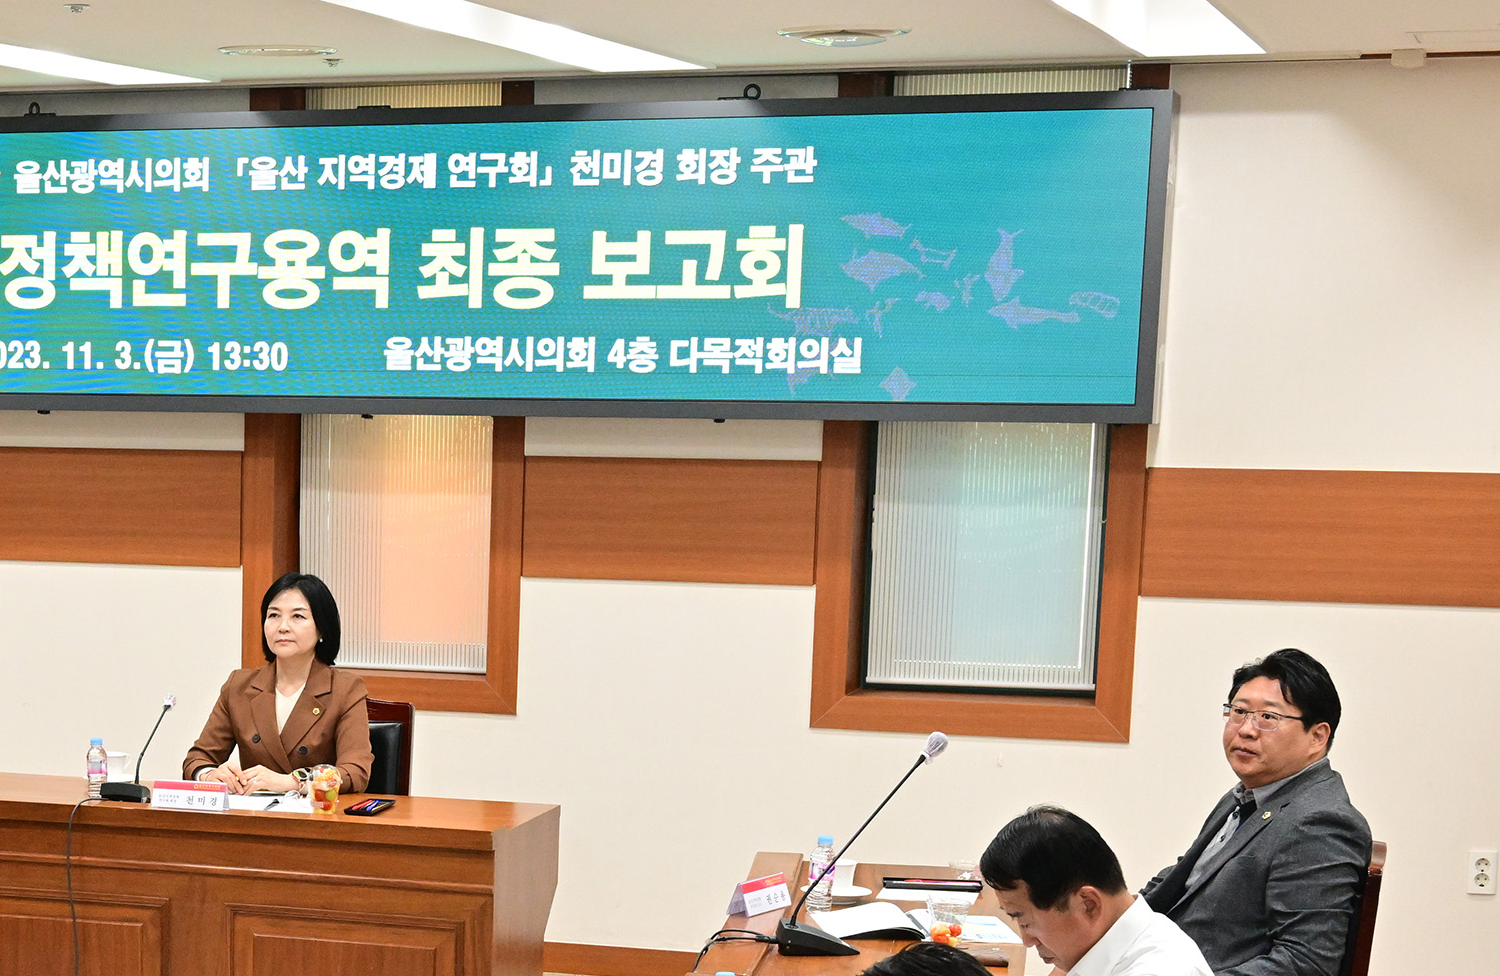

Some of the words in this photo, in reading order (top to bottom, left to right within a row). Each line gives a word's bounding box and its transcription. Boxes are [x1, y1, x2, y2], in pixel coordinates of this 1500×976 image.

[13, 156, 210, 194] 울산광역시의회
[317, 152, 437, 191] 지역경제
[447, 151, 552, 188] 연구회」
[569, 149, 664, 186] 천미경
[675, 147, 741, 186] 회장
[750, 146, 818, 184] 주관
[416, 226, 560, 310] 최종
[583, 223, 805, 309] 보고회
[62, 341, 104, 370] 11.
[207, 341, 289, 371] 13:30
[383, 335, 596, 373] 울산광역시의회
[607, 337, 660, 374] 4층
[669, 336, 863, 374] 다목적회의실
